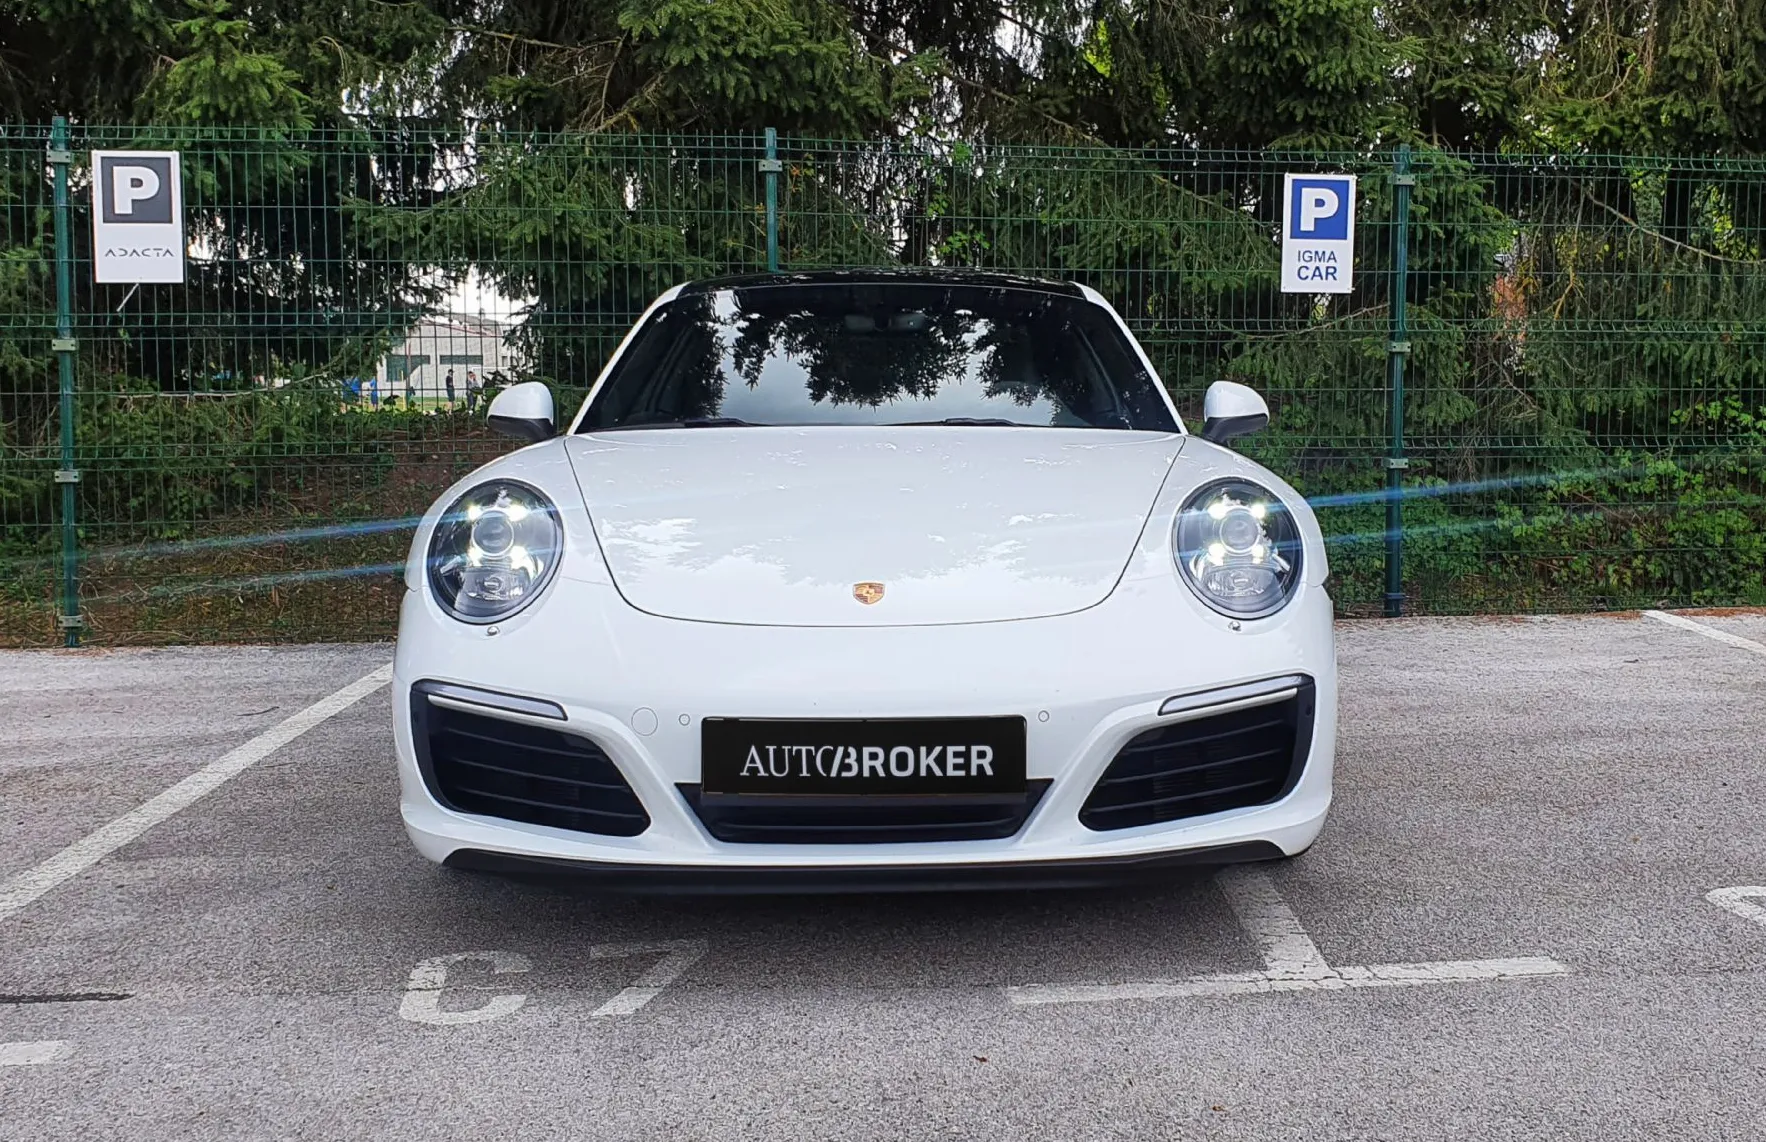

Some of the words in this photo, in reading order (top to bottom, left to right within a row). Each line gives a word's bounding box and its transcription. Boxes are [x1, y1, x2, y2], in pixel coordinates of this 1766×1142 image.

[112, 165, 160, 215] P
[1300, 187, 1339, 232] P
[104, 248, 174, 257] ADACTA
[1297, 250, 1337, 263] IGMA
[1297, 265, 1337, 281] CAR
